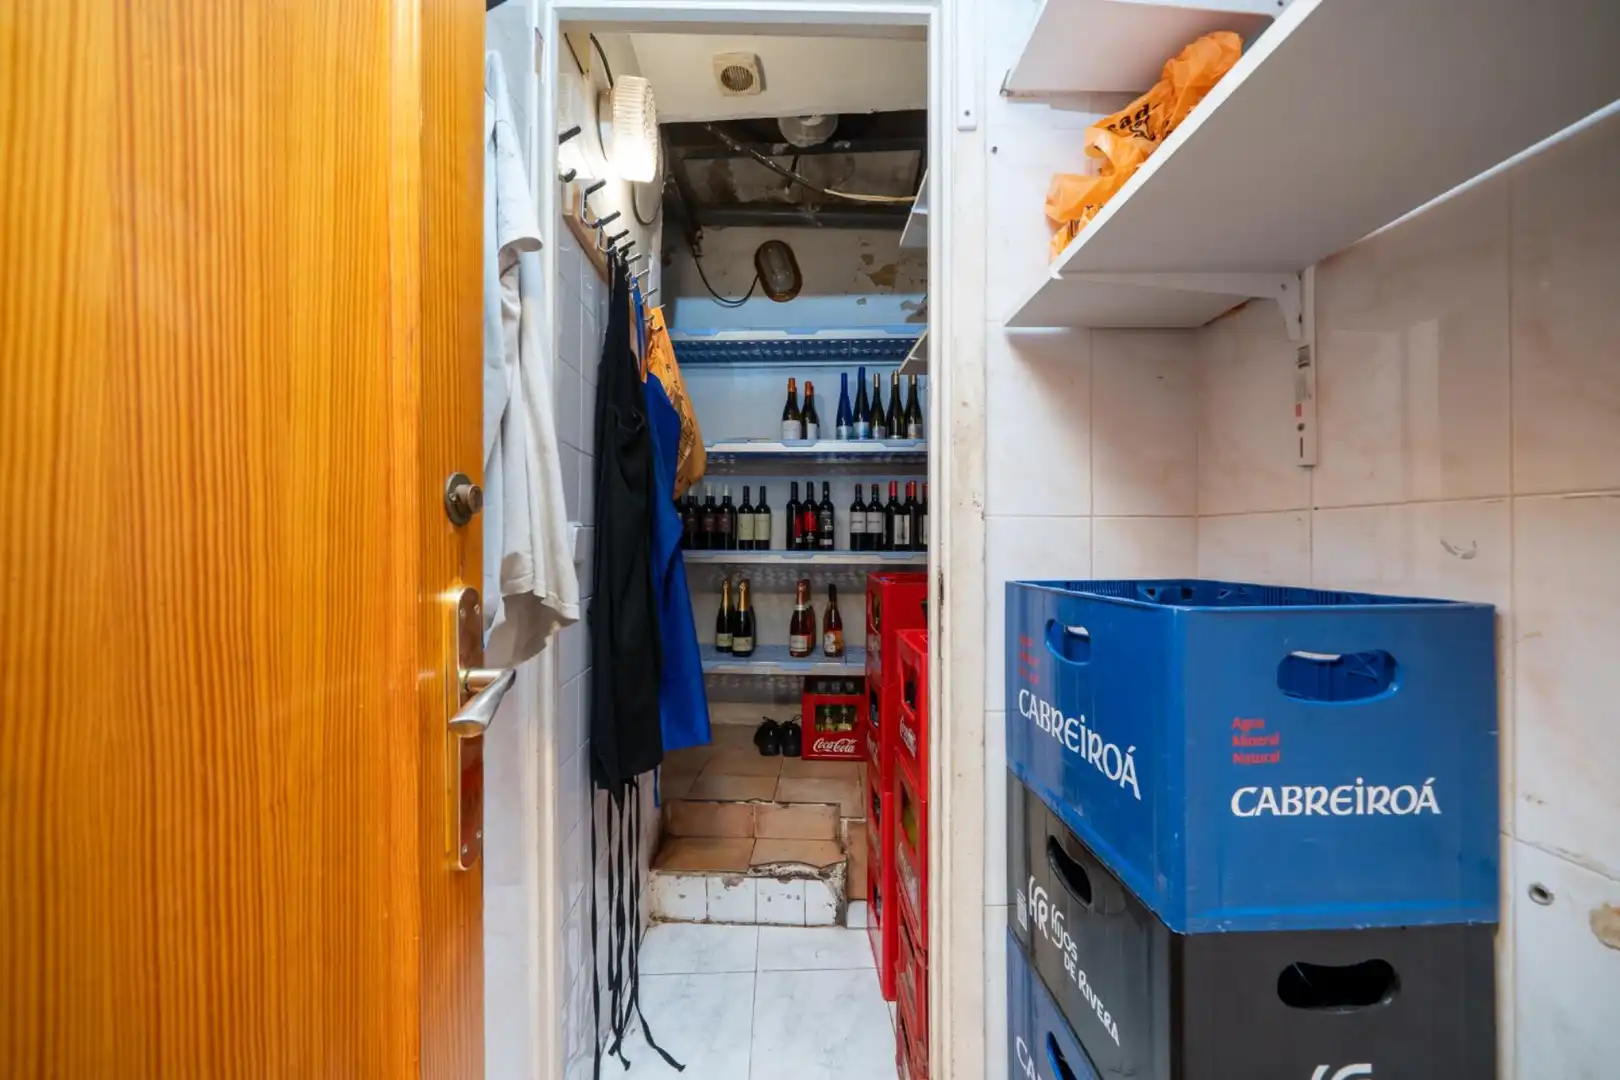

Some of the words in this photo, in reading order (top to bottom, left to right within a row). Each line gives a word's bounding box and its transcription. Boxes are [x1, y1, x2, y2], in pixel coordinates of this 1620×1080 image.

[1232, 731, 1279, 746] Mineral
[1232, 751, 1280, 764] Natural
[1063, 951, 1077, 982] DE
[1078, 969, 1120, 1047] RIVERA
[1016, 1035, 1042, 1080] CA
